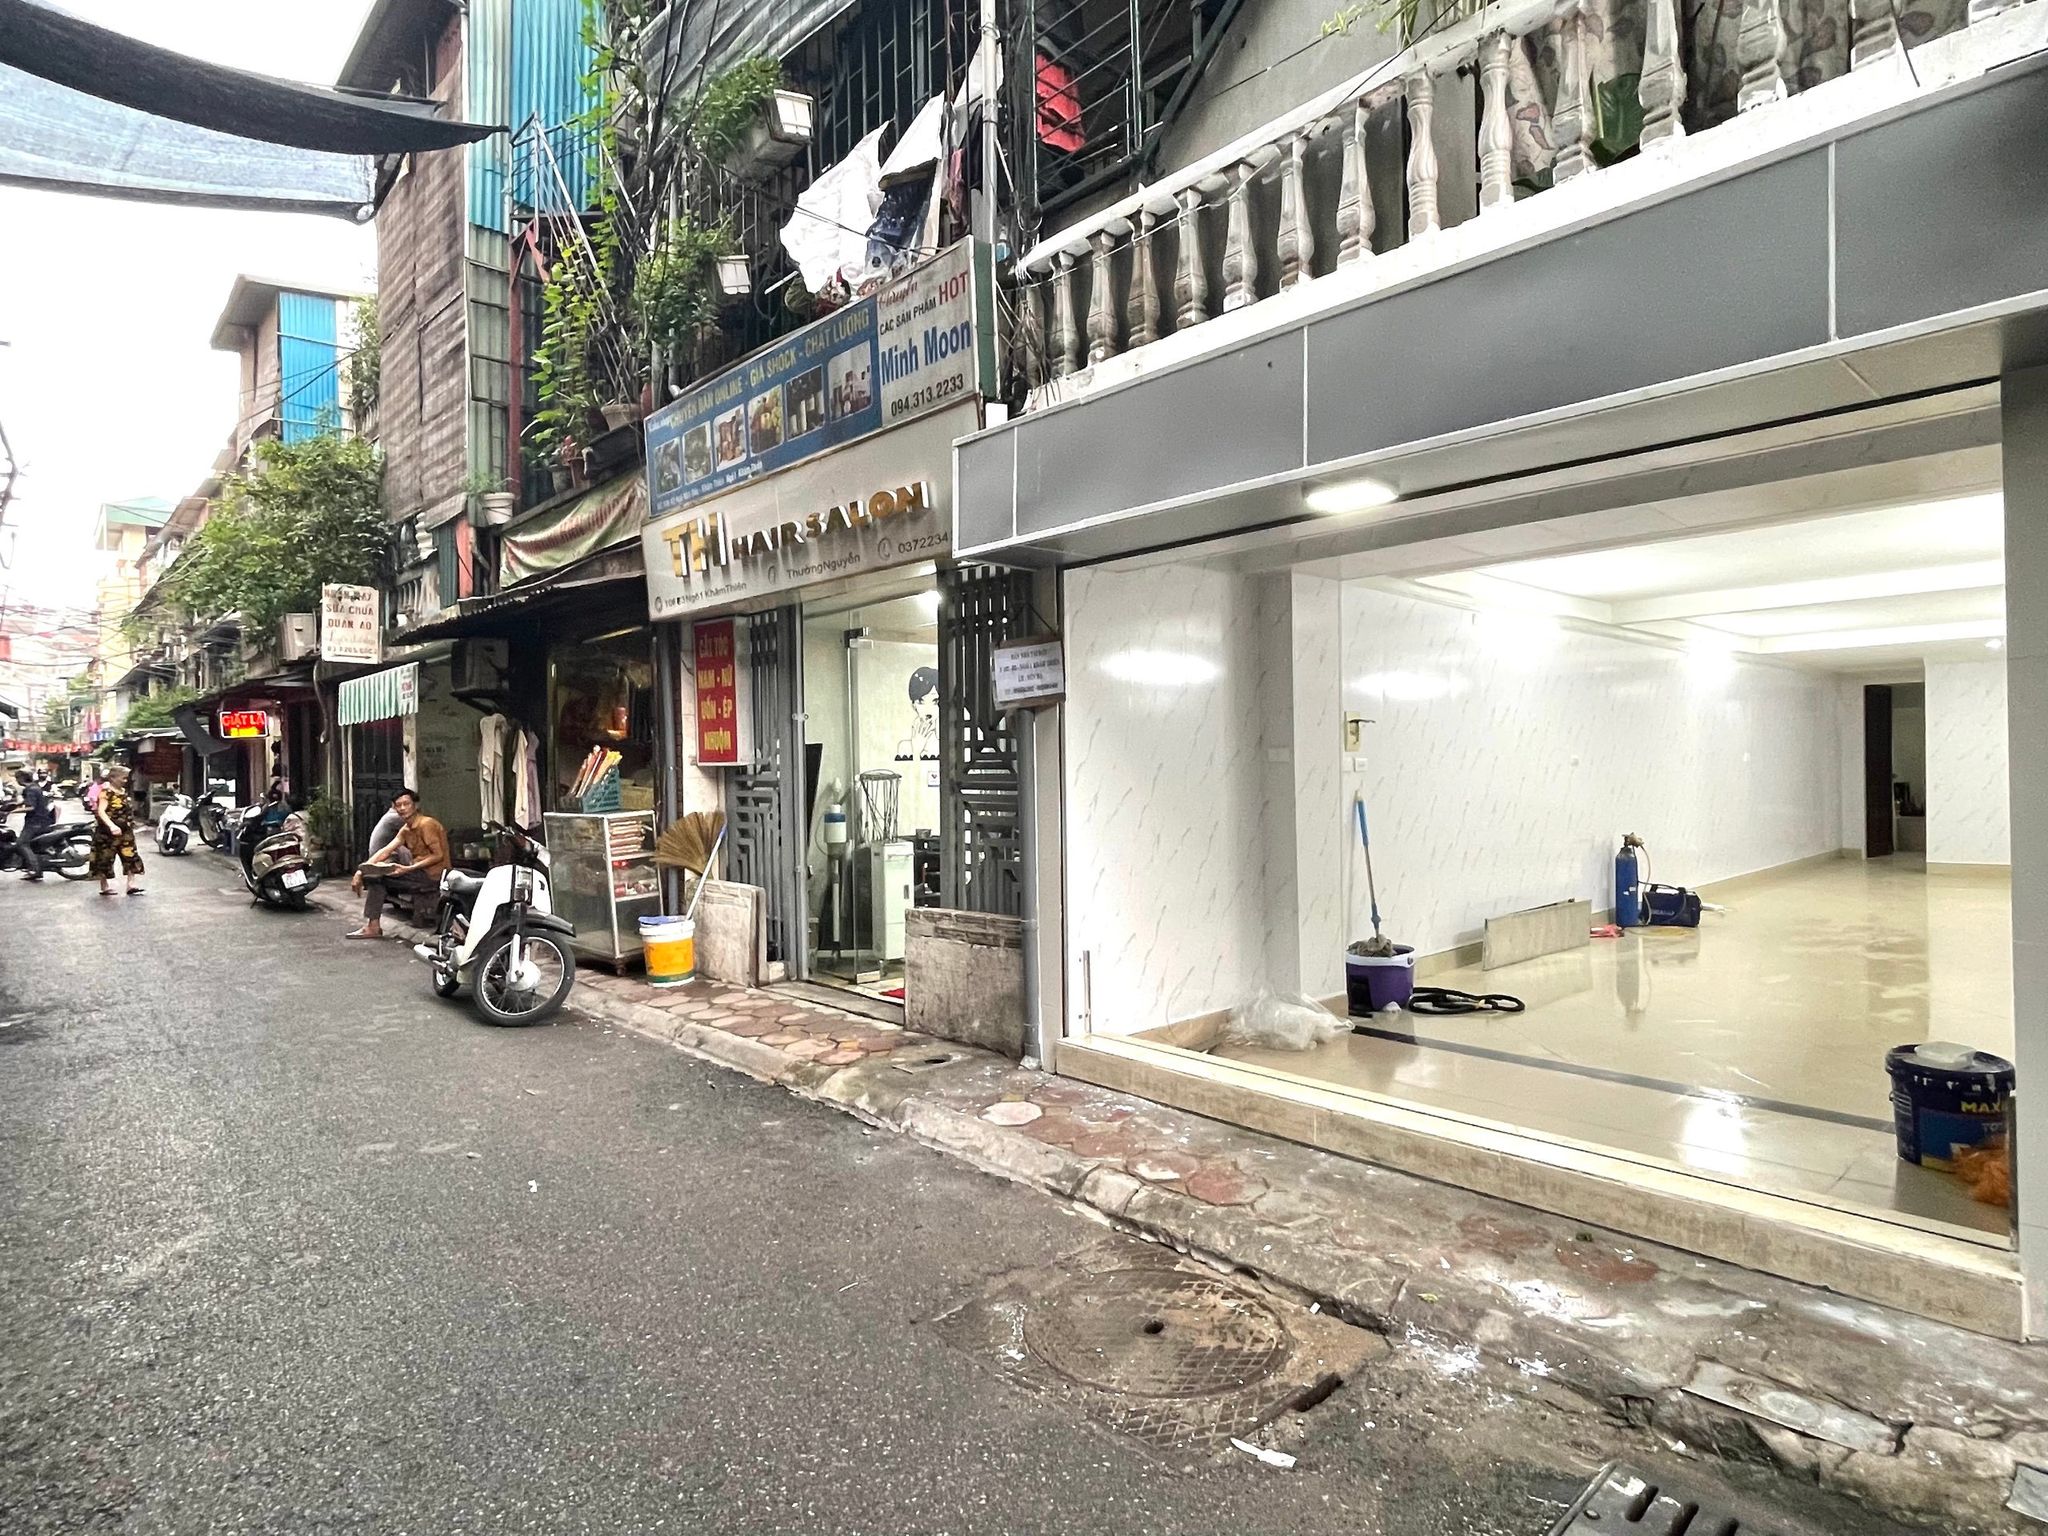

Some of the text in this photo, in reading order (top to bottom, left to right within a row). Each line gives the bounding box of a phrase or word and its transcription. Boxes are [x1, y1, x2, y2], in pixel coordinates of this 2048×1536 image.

[939, 271, 968, 306] HOT
[767, 346, 798, 378] SHOCK
[881, 319, 972, 386] Minh Moon
[891, 373, 964, 417] 094.313.2233
[661, 480, 930, 578] TH HAIR SALON
[898, 532, 949, 554] 0372234
